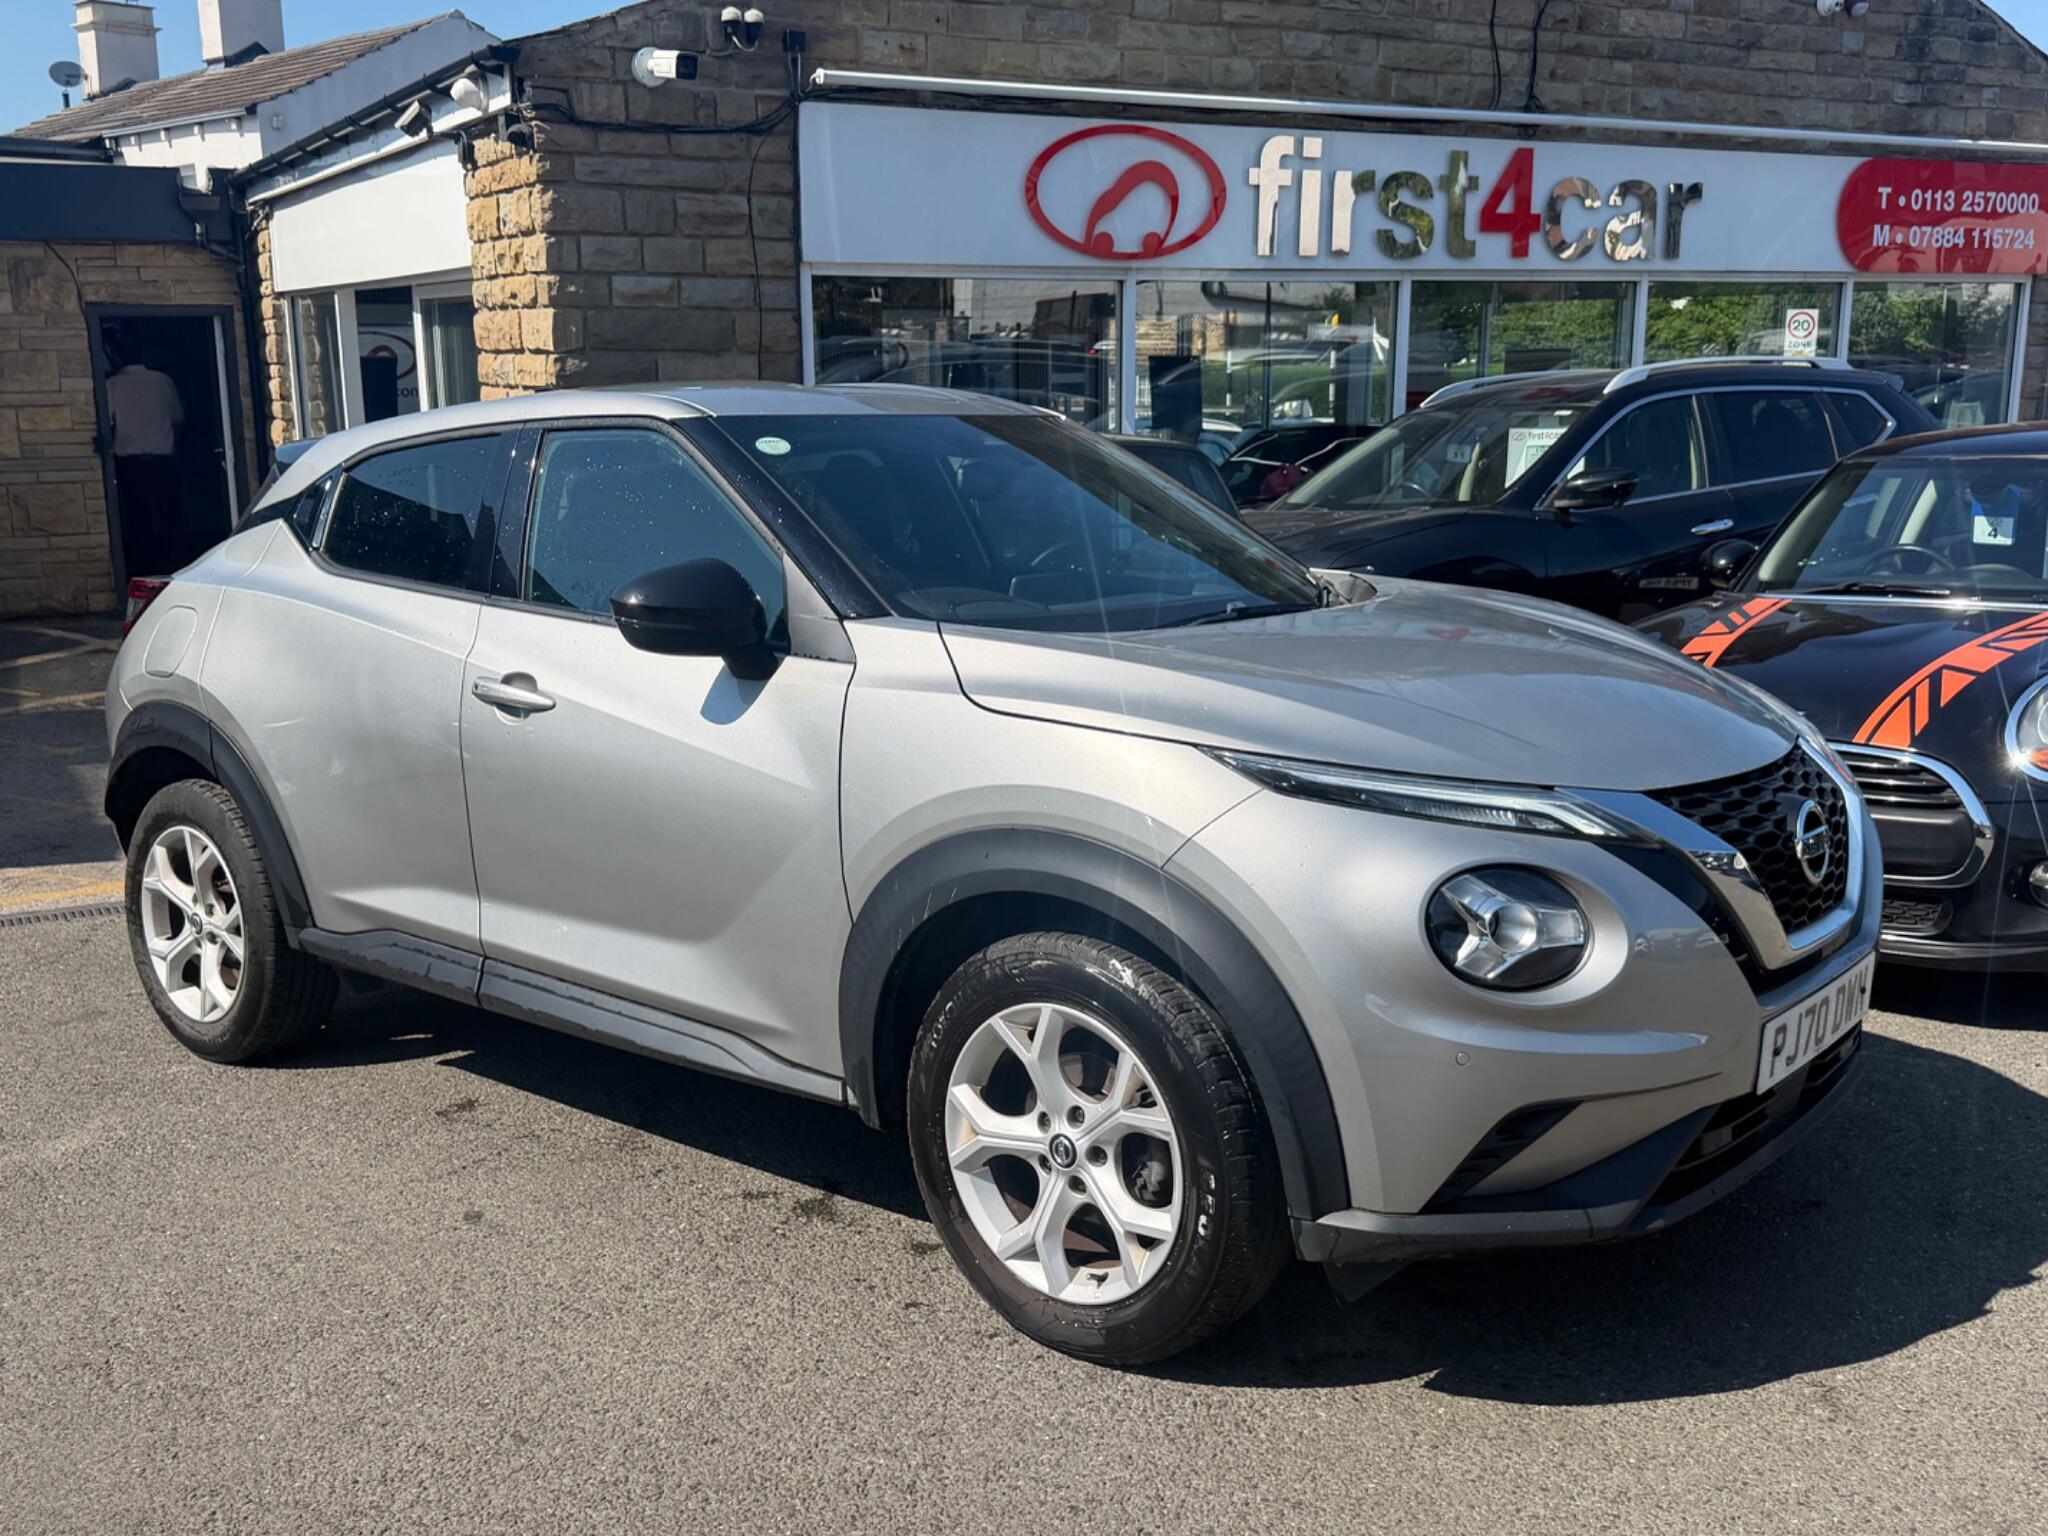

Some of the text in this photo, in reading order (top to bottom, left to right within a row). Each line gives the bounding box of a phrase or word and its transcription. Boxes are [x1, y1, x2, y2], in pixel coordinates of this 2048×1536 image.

[1248, 135, 1703, 261] first4car
[1877, 186, 2040, 214] T 0113 2570000
[1872, 223, 2035, 250] M 07884 115724
[1791, 318, 1811, 332] 20
[1787, 340, 1813, 349] ZONE
[1987, 527, 1998, 539] 4
[1769, 994, 1829, 1080] PJ70
